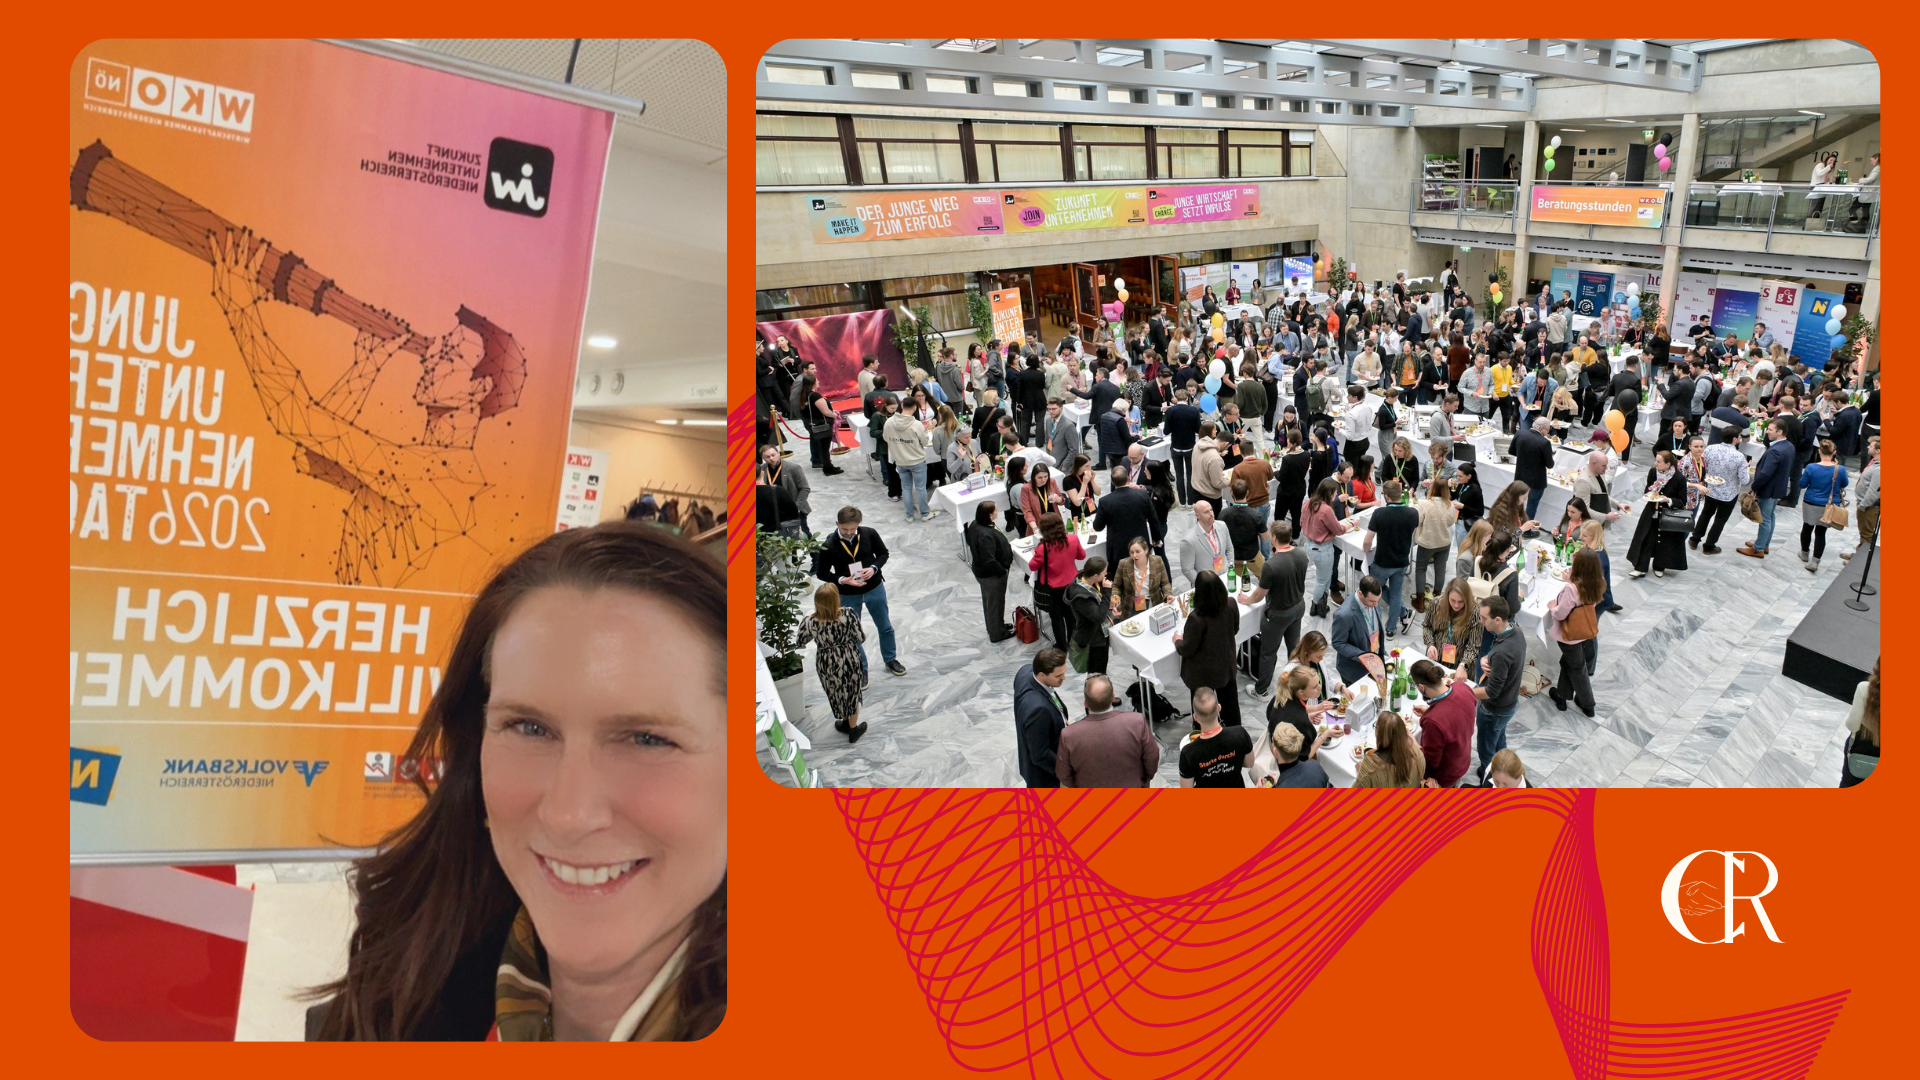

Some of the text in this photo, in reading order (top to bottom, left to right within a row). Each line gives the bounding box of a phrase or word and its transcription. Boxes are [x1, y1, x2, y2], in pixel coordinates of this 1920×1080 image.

[1055, 193, 1097, 211] ZUKUNFT
[1174, 188, 1238, 209] JUNGE WIRTSCHAFT
[1537, 197, 1632, 213] Beratungsstunden
[856, 195, 960, 222] DER JUNGE WEG
[1023, 209, 1041, 221] JOIN
[1045, 205, 1113, 227] UNTERNEHMEN
[1154, 208, 1173, 218] CHANGE
[1182, 201, 1232, 219] SETZT IMPULSE
[831, 218, 857, 228] MAKE IT
[833, 226, 859, 236] HAPPEN
[873, 213, 952, 237] ZUM ERFOLG
[993, 304, 1022, 323] ZUKUNFT
[993, 317, 1024, 335] UNTER-
[1198, 758, 1217, 768] Starte
